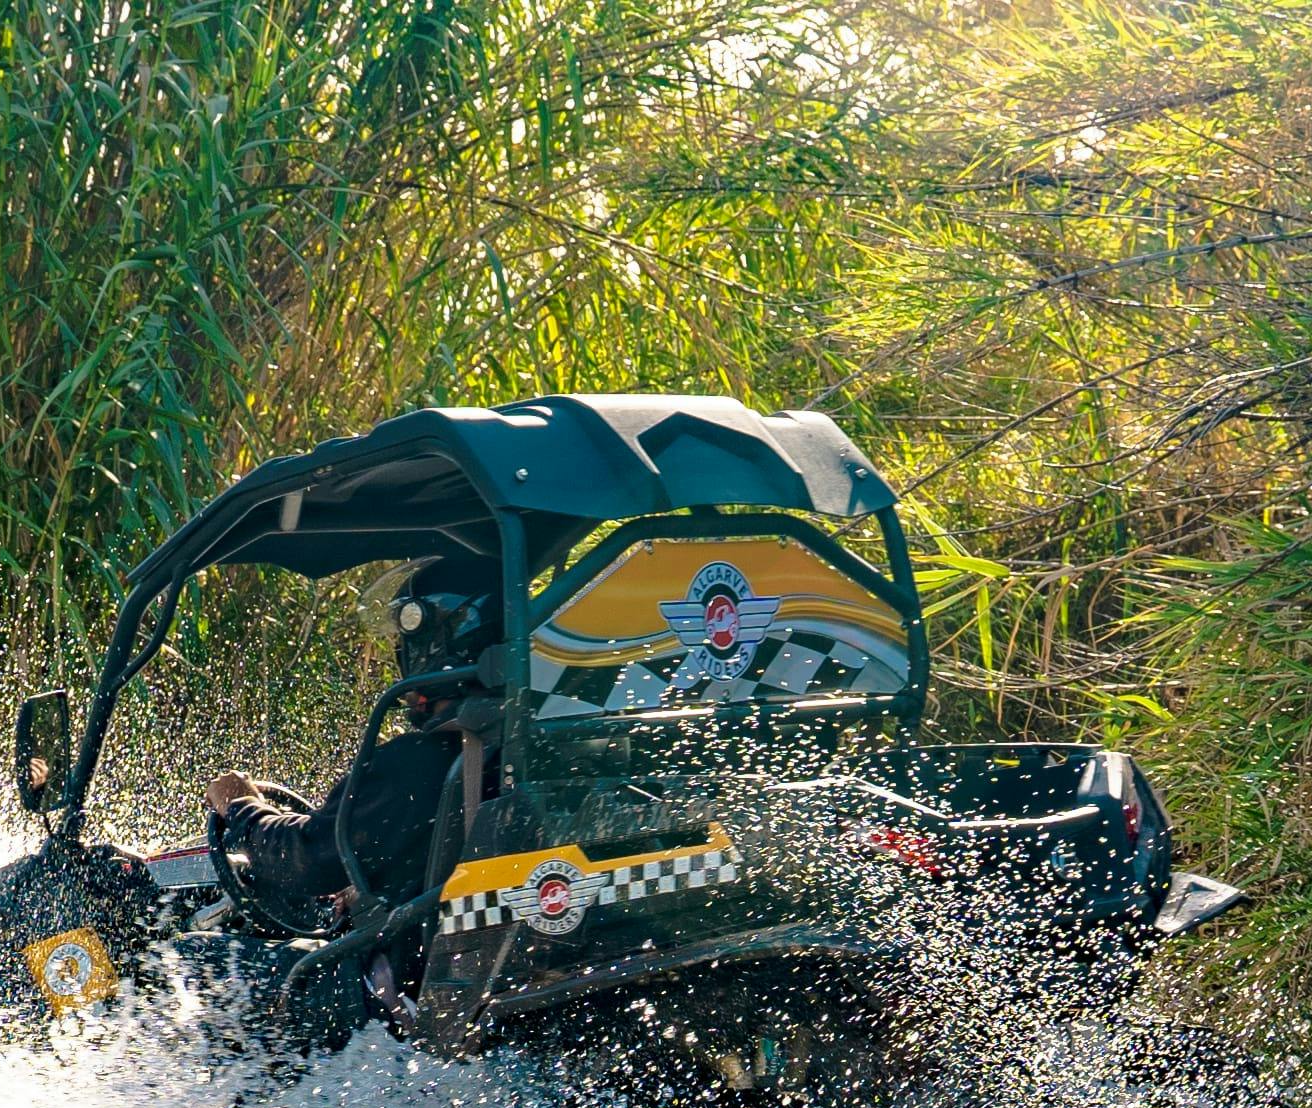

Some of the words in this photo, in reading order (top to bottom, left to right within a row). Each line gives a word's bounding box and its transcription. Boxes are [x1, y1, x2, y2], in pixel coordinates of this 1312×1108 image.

[692, 566, 749, 599] ALGARVE
[697, 646, 749, 677] RIDERS
[529, 863, 580, 886] ALGARVE
[533, 910, 578, 930] RIDERS
